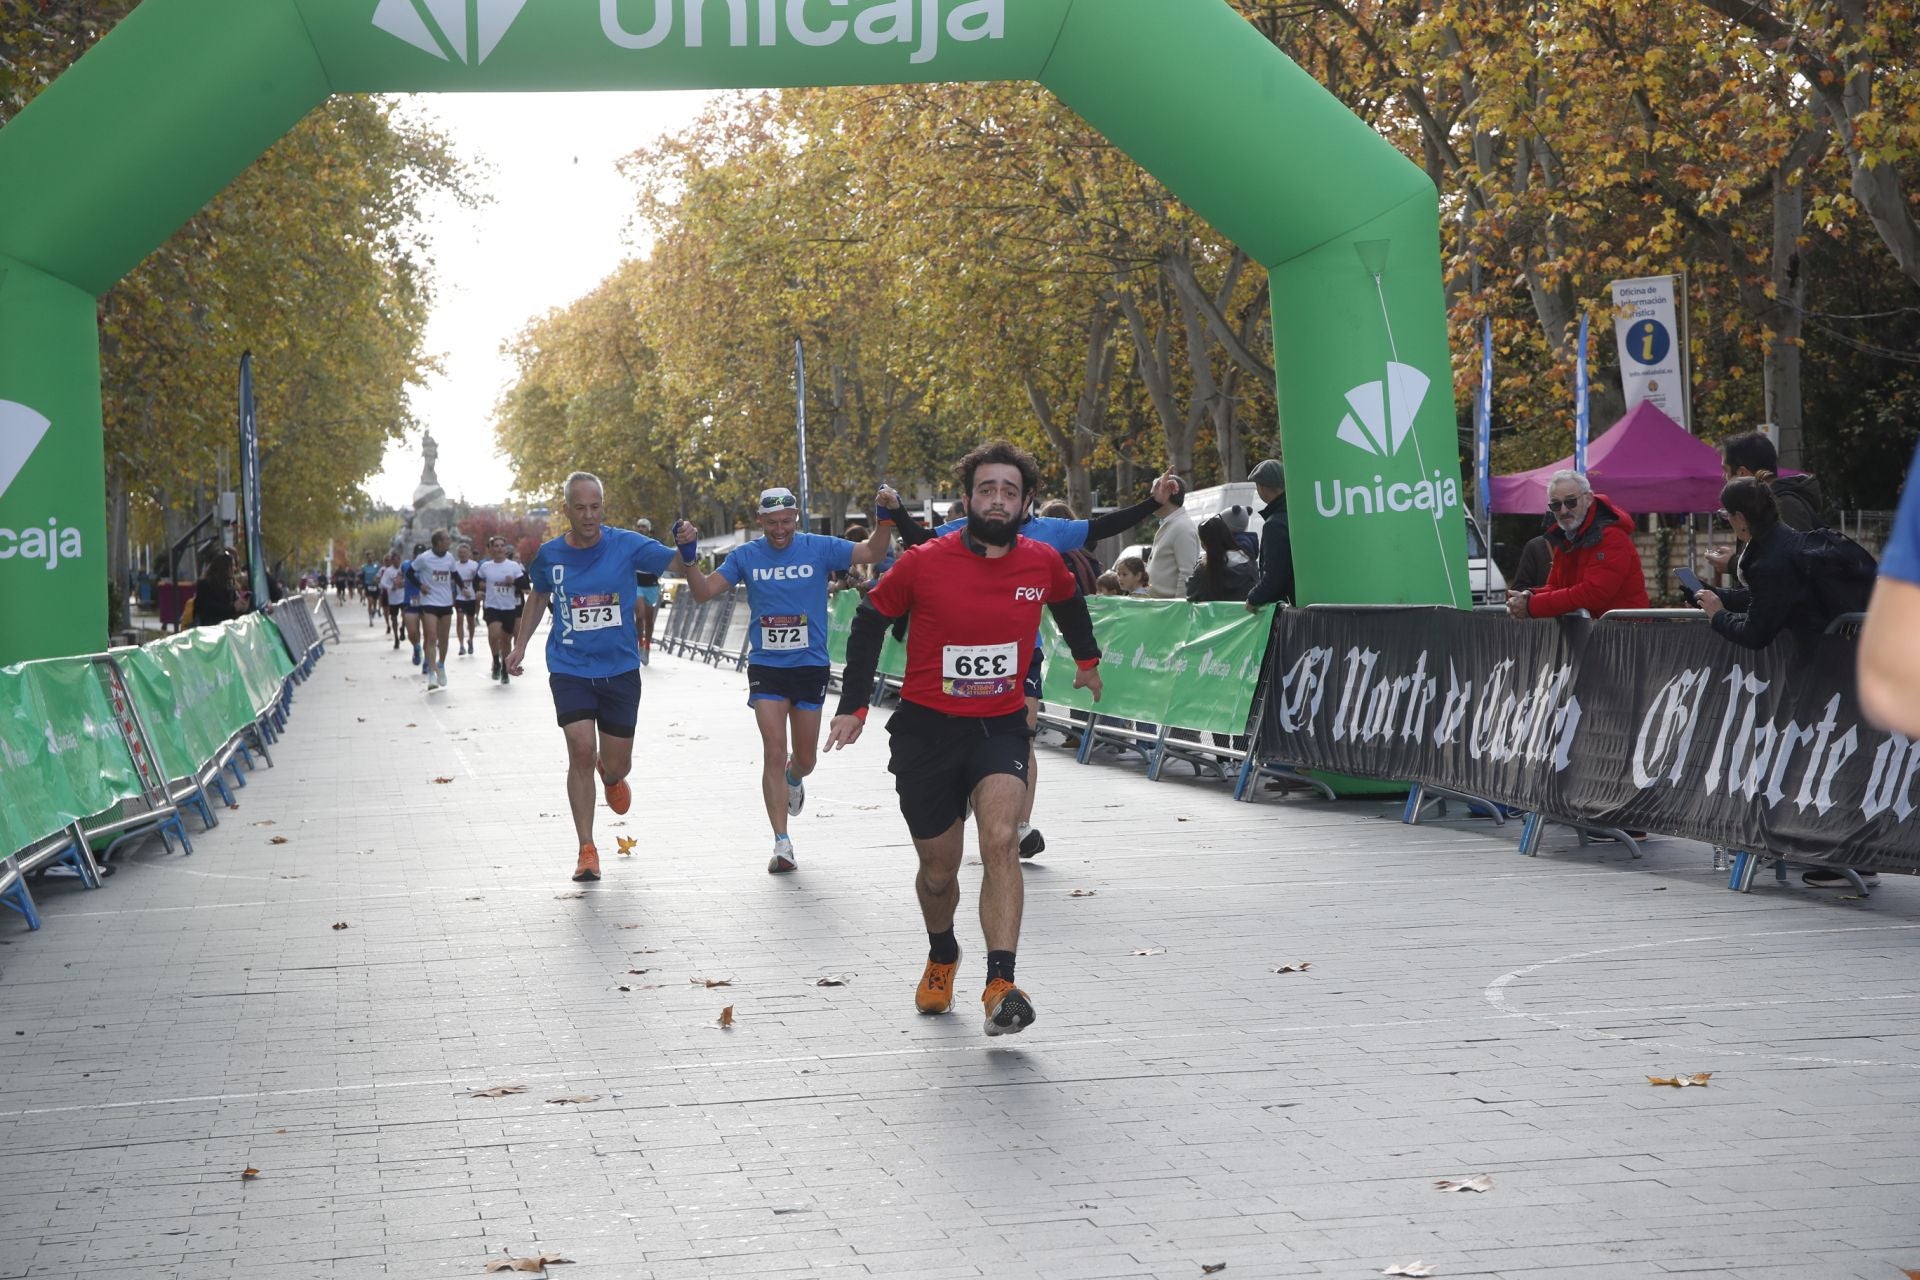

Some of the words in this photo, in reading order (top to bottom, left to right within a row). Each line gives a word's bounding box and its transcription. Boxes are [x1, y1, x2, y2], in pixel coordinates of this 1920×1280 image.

[1620, 287, 1646, 296] Oficina
[1314, 469, 1458, 519] Unicaja
[753, 564, 813, 581] IVECO
[552, 564, 573, 645] IVECO
[579, 607, 613, 623] 573
[768, 628, 801, 643] 572
[955, 654, 1008, 677] 339
[1280, 646, 1333, 737] El
[1333, 646, 1436, 745] Norte
[1633, 666, 1710, 789] El
[1705, 664, 1858, 817] Norte
